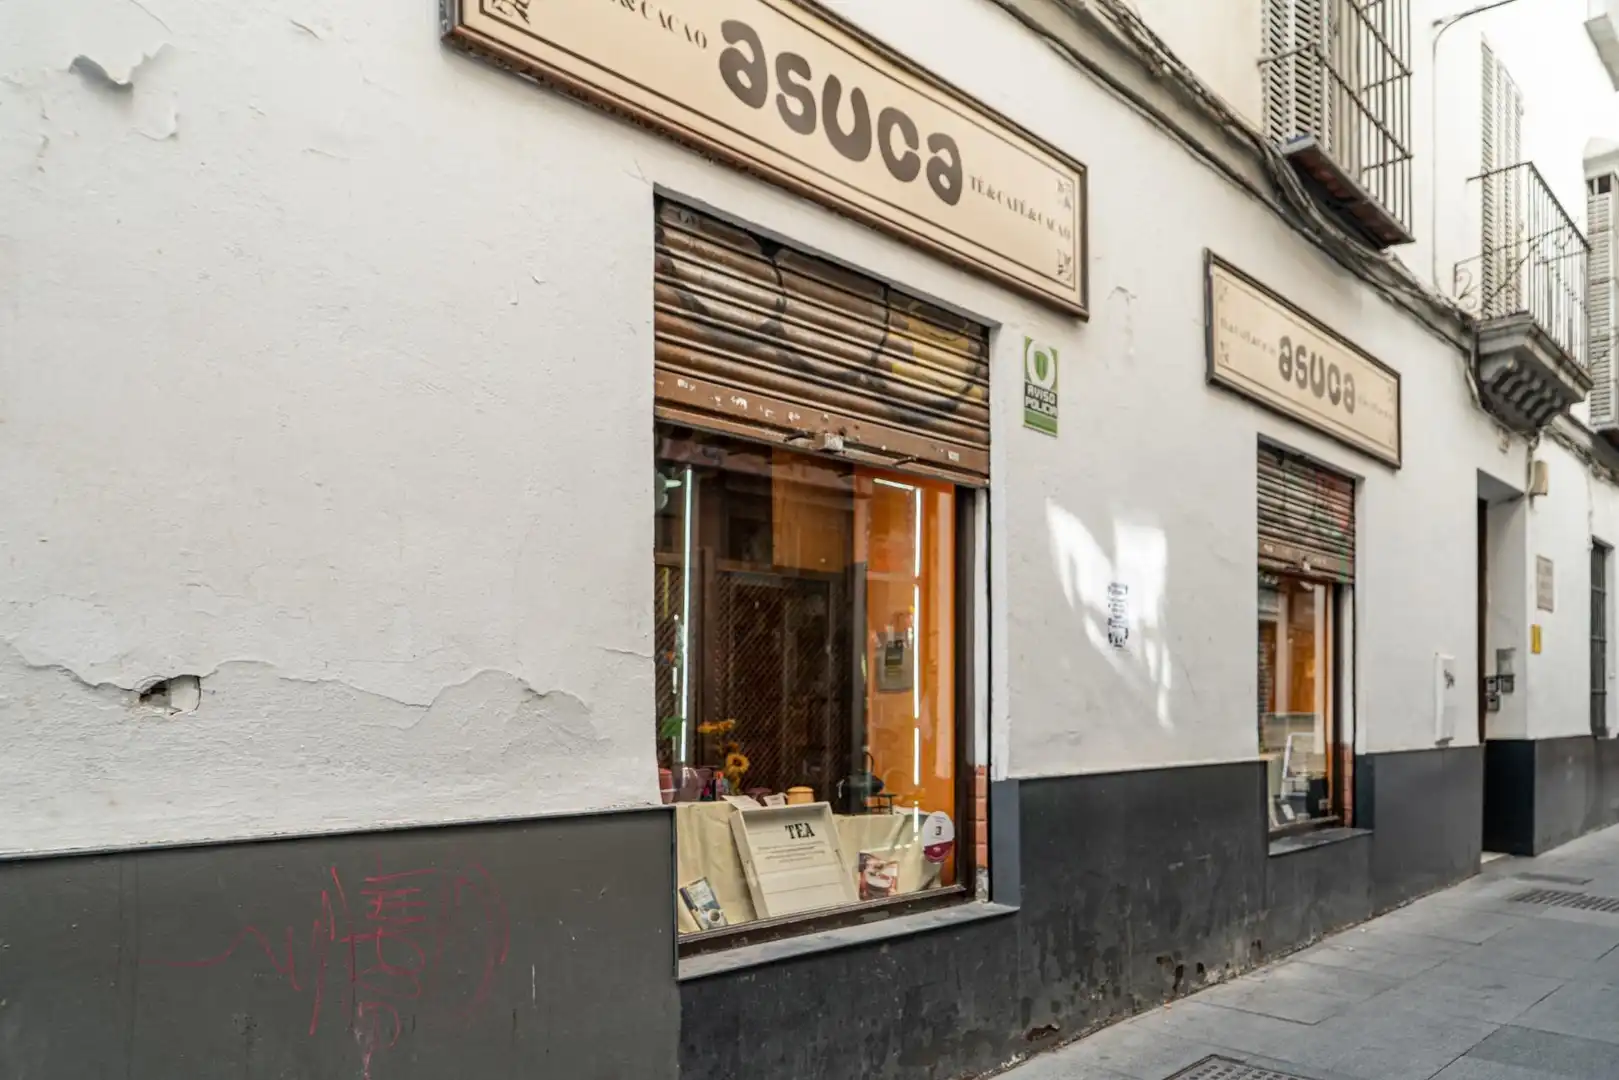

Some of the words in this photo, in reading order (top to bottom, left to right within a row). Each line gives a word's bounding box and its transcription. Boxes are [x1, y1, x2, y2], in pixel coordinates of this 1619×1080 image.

[719, 19, 963, 207] asuca
[1278, 335, 1356, 415] asuca
[784, 822, 816, 840] TEA
